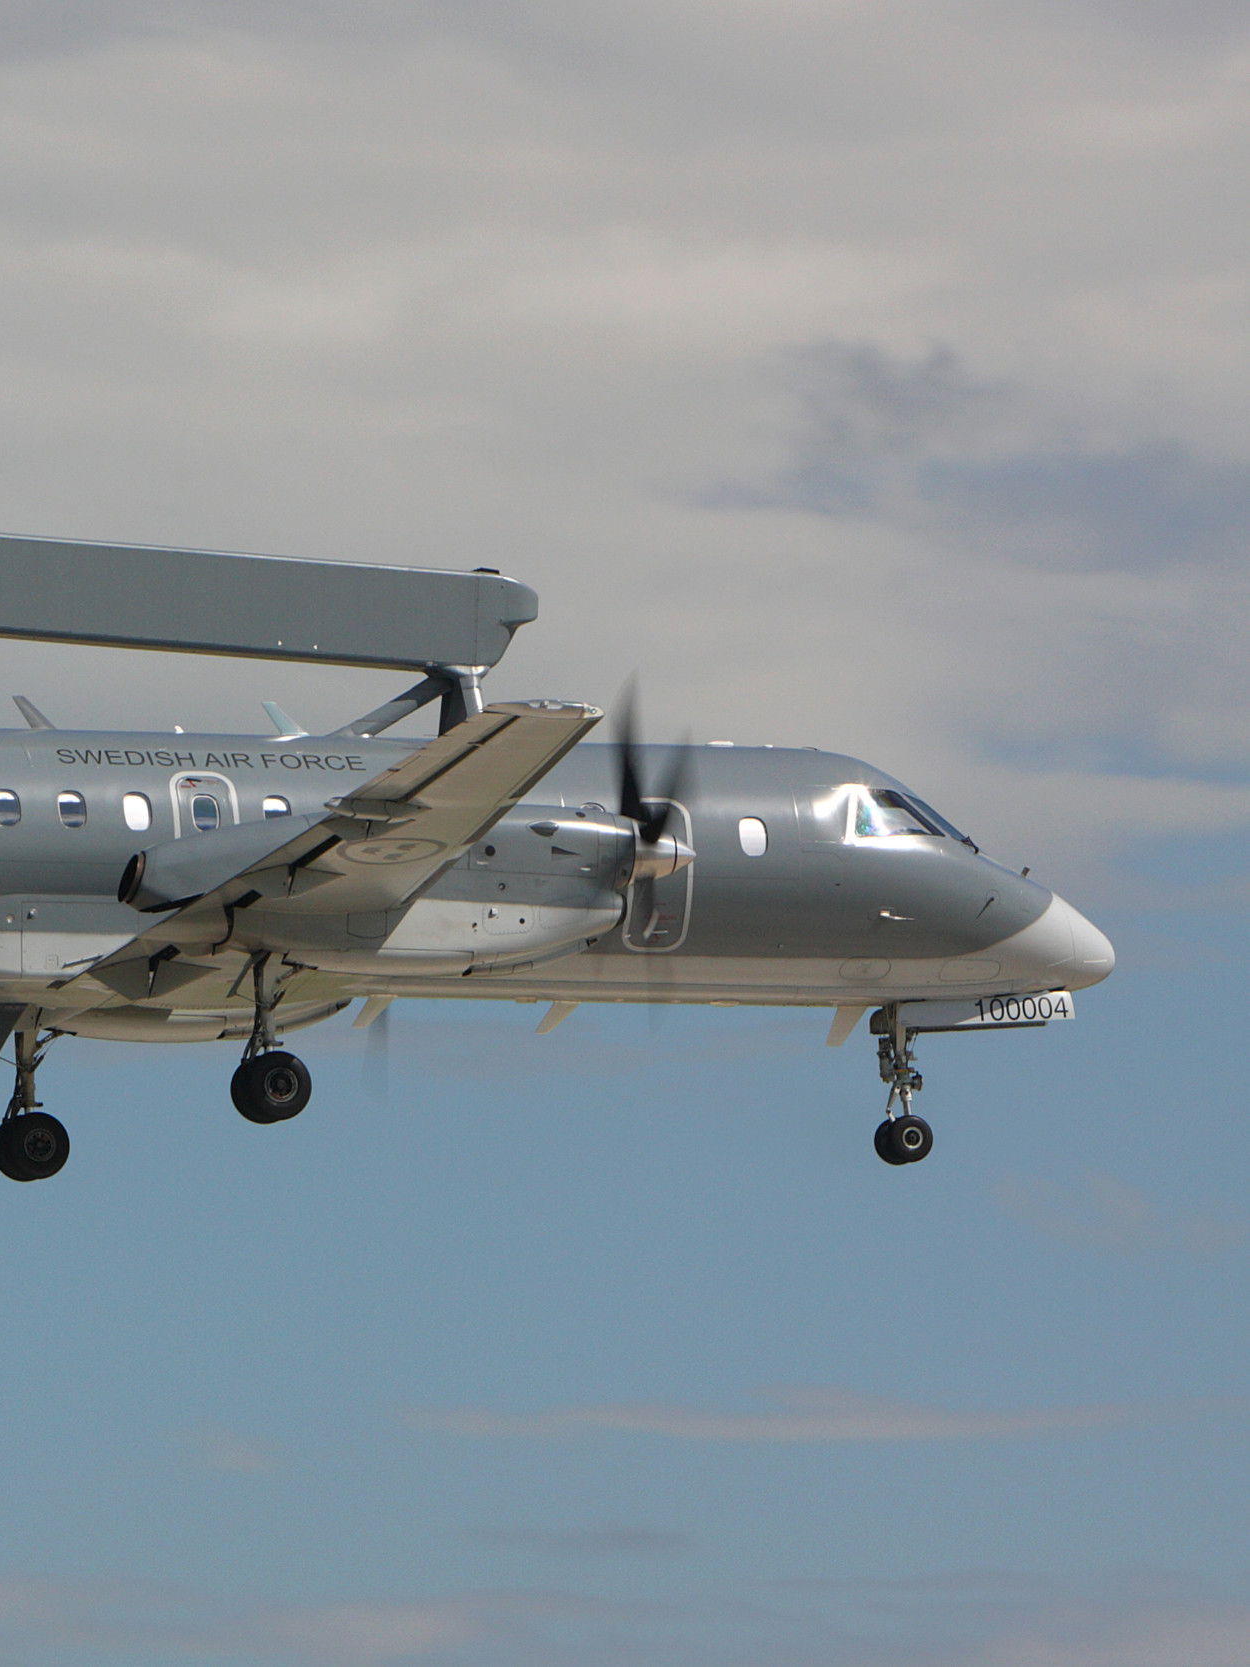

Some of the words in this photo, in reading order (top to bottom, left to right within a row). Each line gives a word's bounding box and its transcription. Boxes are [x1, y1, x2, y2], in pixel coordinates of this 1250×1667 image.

[56, 748, 196, 768] SWEDISH
[205, 752, 254, 769] AIR
[260, 753, 367, 771] FORCE
[975, 996, 1069, 1021] 100004
